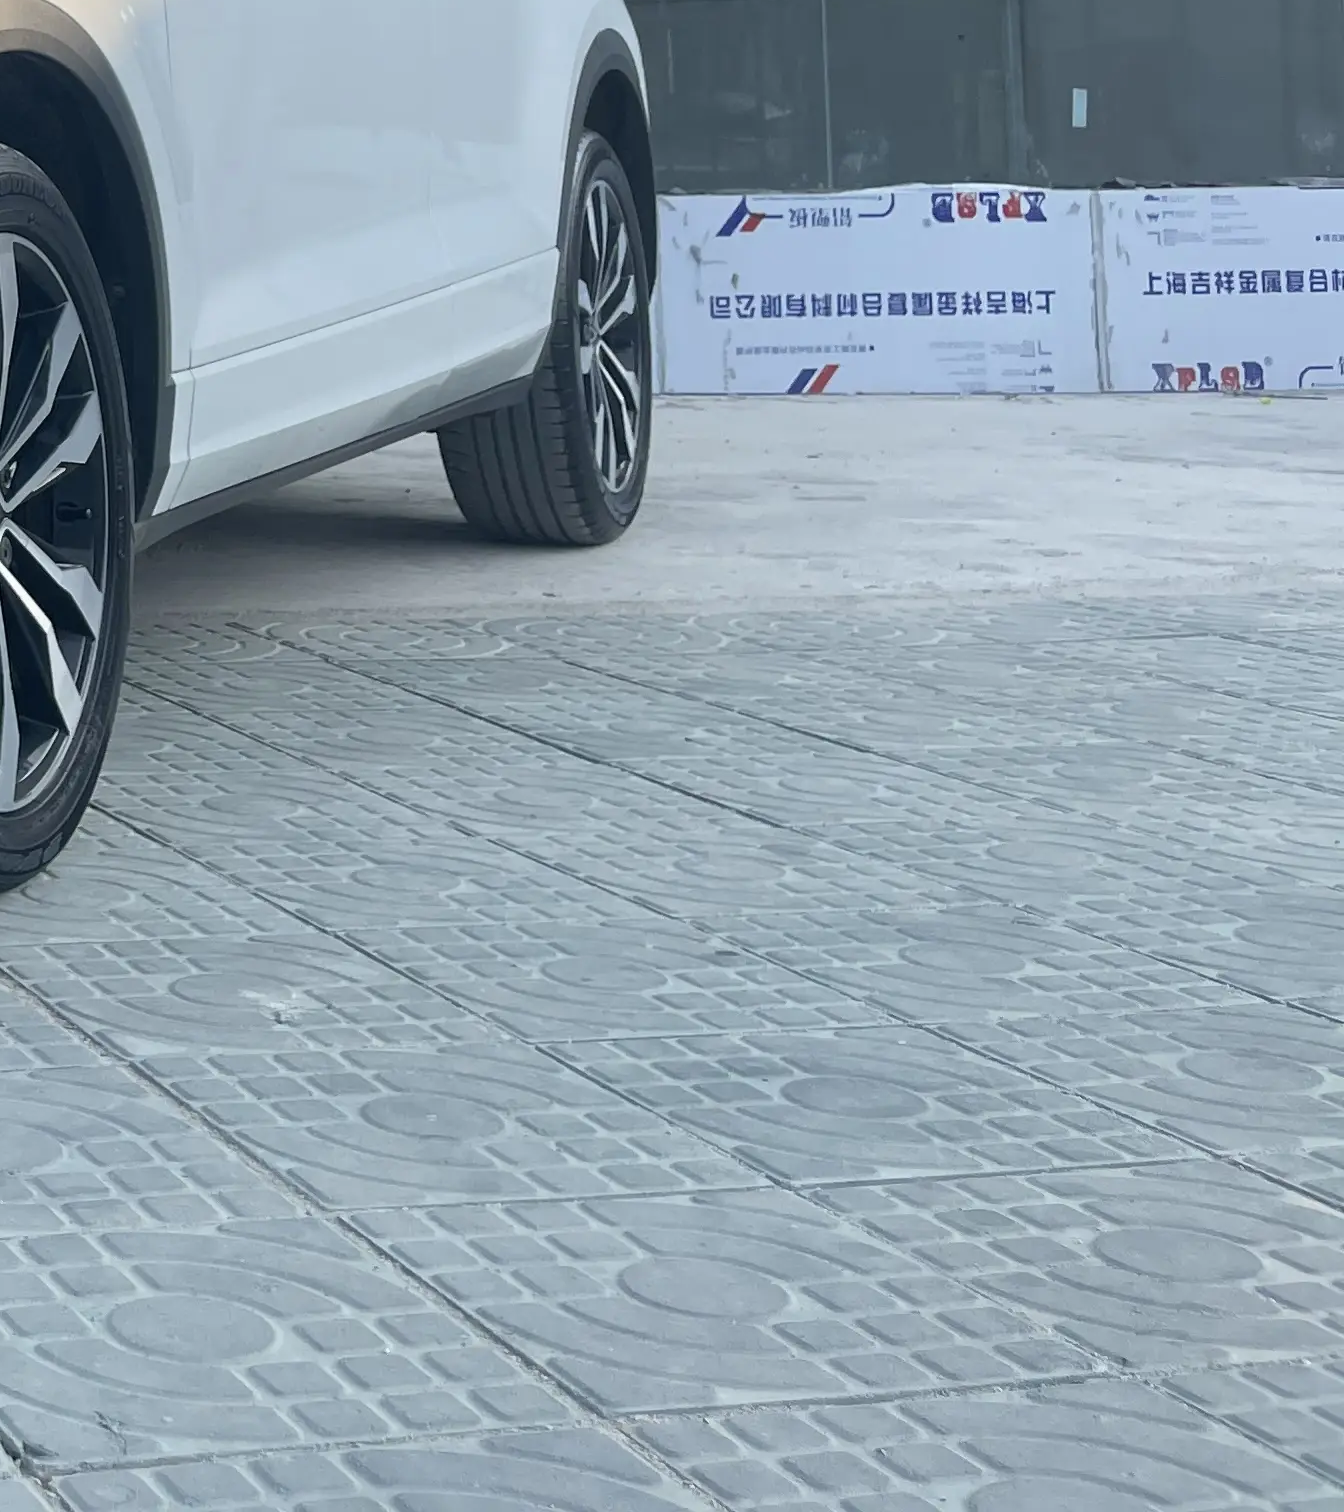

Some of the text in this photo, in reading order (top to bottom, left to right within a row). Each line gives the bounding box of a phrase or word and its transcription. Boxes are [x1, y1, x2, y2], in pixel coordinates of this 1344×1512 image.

[710, 290, 1057, 319] 上海吉祥金属复合材料有限公司
